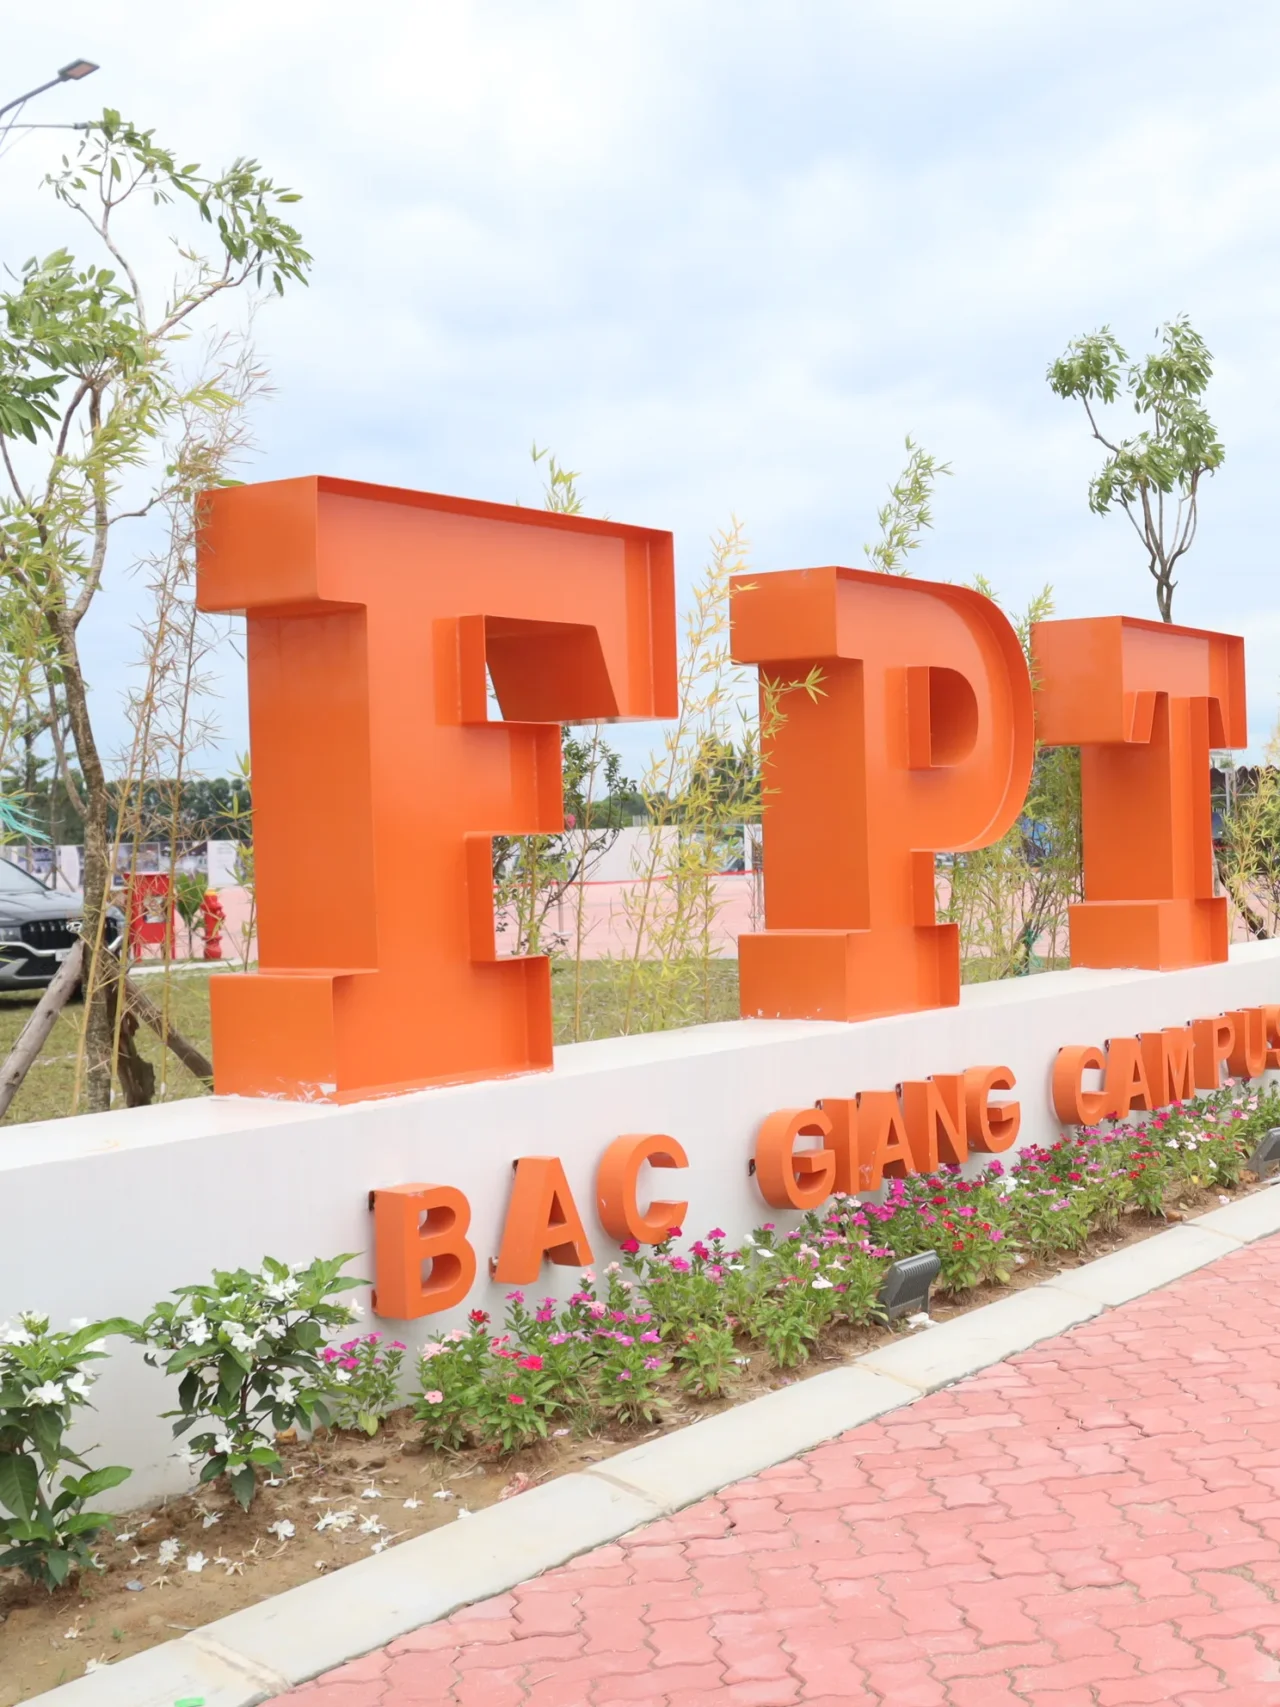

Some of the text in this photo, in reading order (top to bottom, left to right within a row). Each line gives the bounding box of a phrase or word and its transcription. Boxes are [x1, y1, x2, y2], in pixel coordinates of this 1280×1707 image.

[196, 475, 1246, 1104] FPT
[371, 1134, 689, 1320] BAC
[755, 1065, 1020, 1210] GIANG
